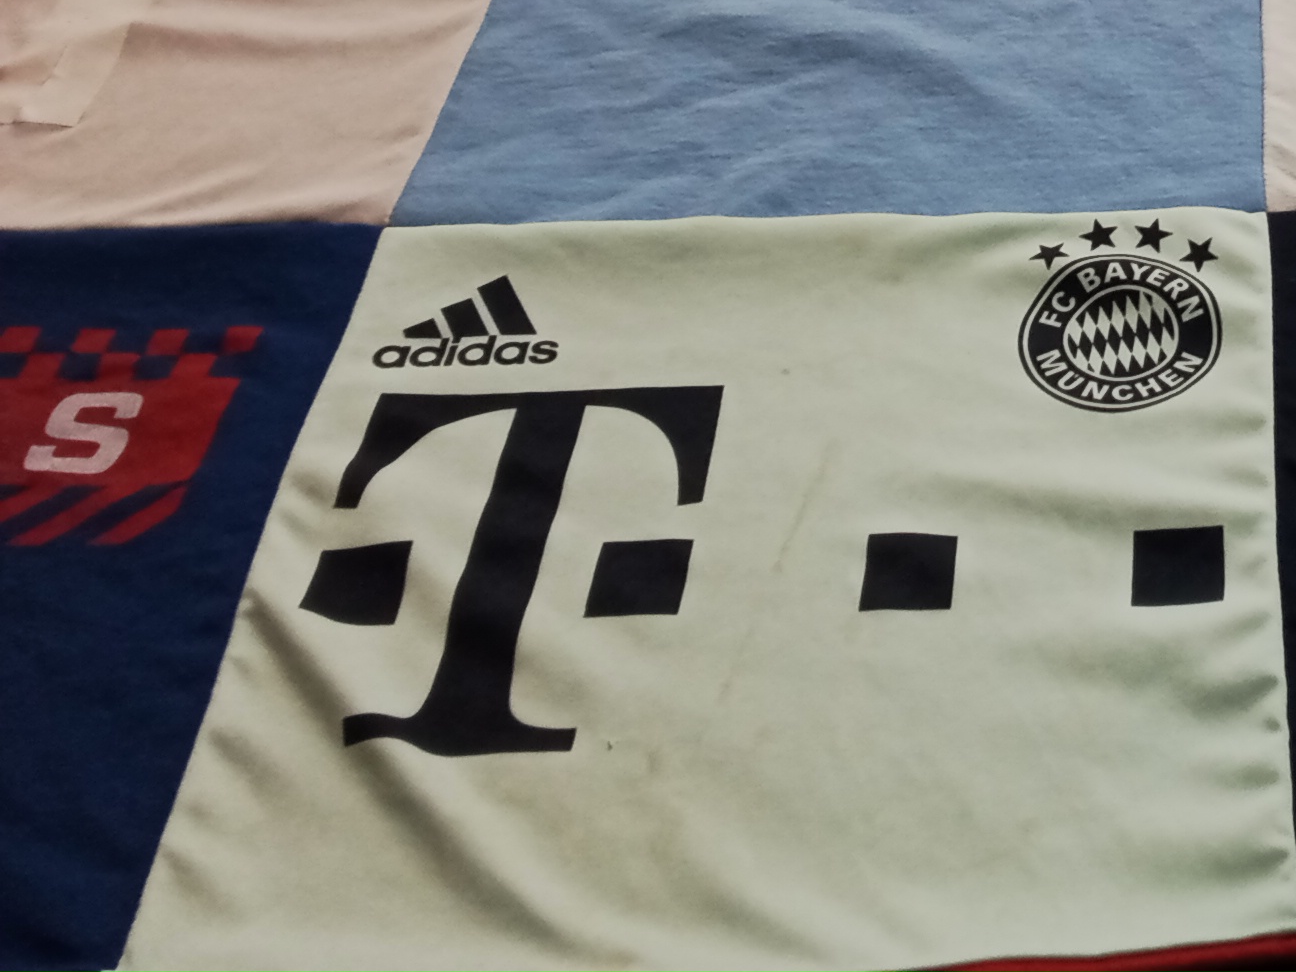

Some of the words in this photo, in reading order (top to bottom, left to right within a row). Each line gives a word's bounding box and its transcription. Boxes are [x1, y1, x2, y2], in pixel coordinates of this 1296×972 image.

[1039, 291, 1077, 328] FC
[1076, 262, 1205, 324] BAYERN
[371, 333, 559, 369] adidas
[1036, 348, 1204, 402] MÜNCHEN
[23, 391, 144, 475] S
